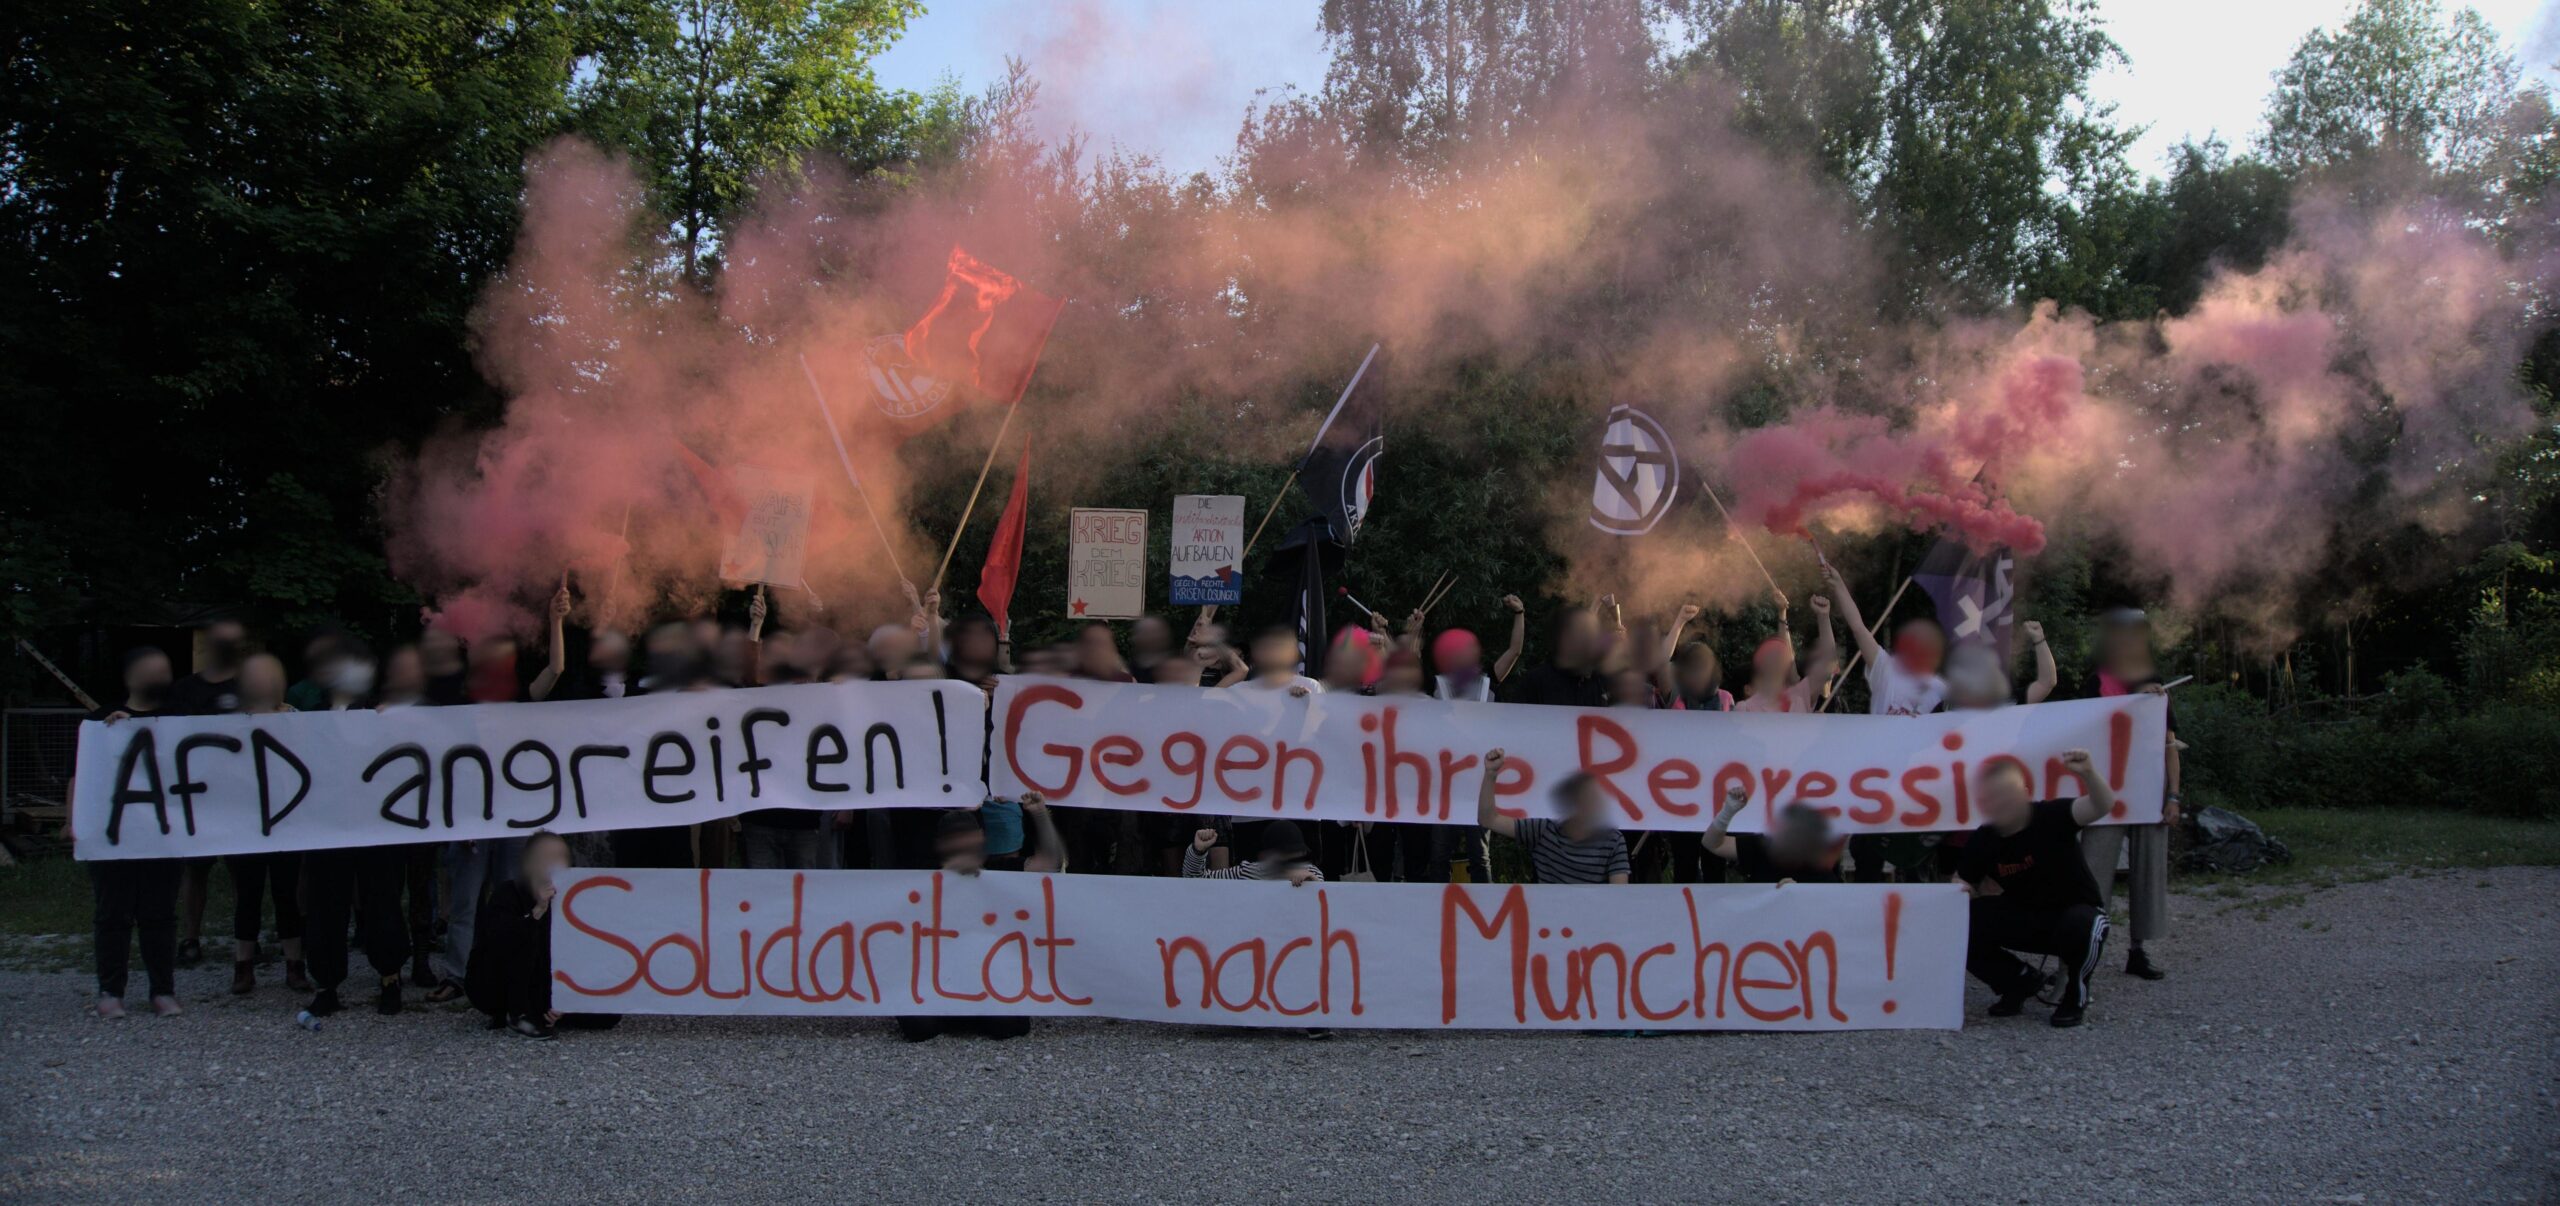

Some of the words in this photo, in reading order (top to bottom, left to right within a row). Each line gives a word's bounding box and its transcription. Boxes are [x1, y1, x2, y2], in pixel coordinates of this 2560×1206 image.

[1197, 497, 1213, 510] DIE
[1073, 515, 1143, 545] KRIEG
[1192, 528, 1225, 543] AKTION
[1090, 547, 1123, 559] DEM
[1171, 544, 1234, 562] AUFBAUEN
[1072, 559, 1142, 588] KRIEG
[1174, 579, 1198, 588] GEGEN
[1201, 579, 1225, 588] RECHTE
[1004, 684, 1326, 811] Gegen
[106, 727, 312, 846] AfD
[553, 867, 1093, 1007] Solidarität
[1155, 889, 1365, 1017] nach
